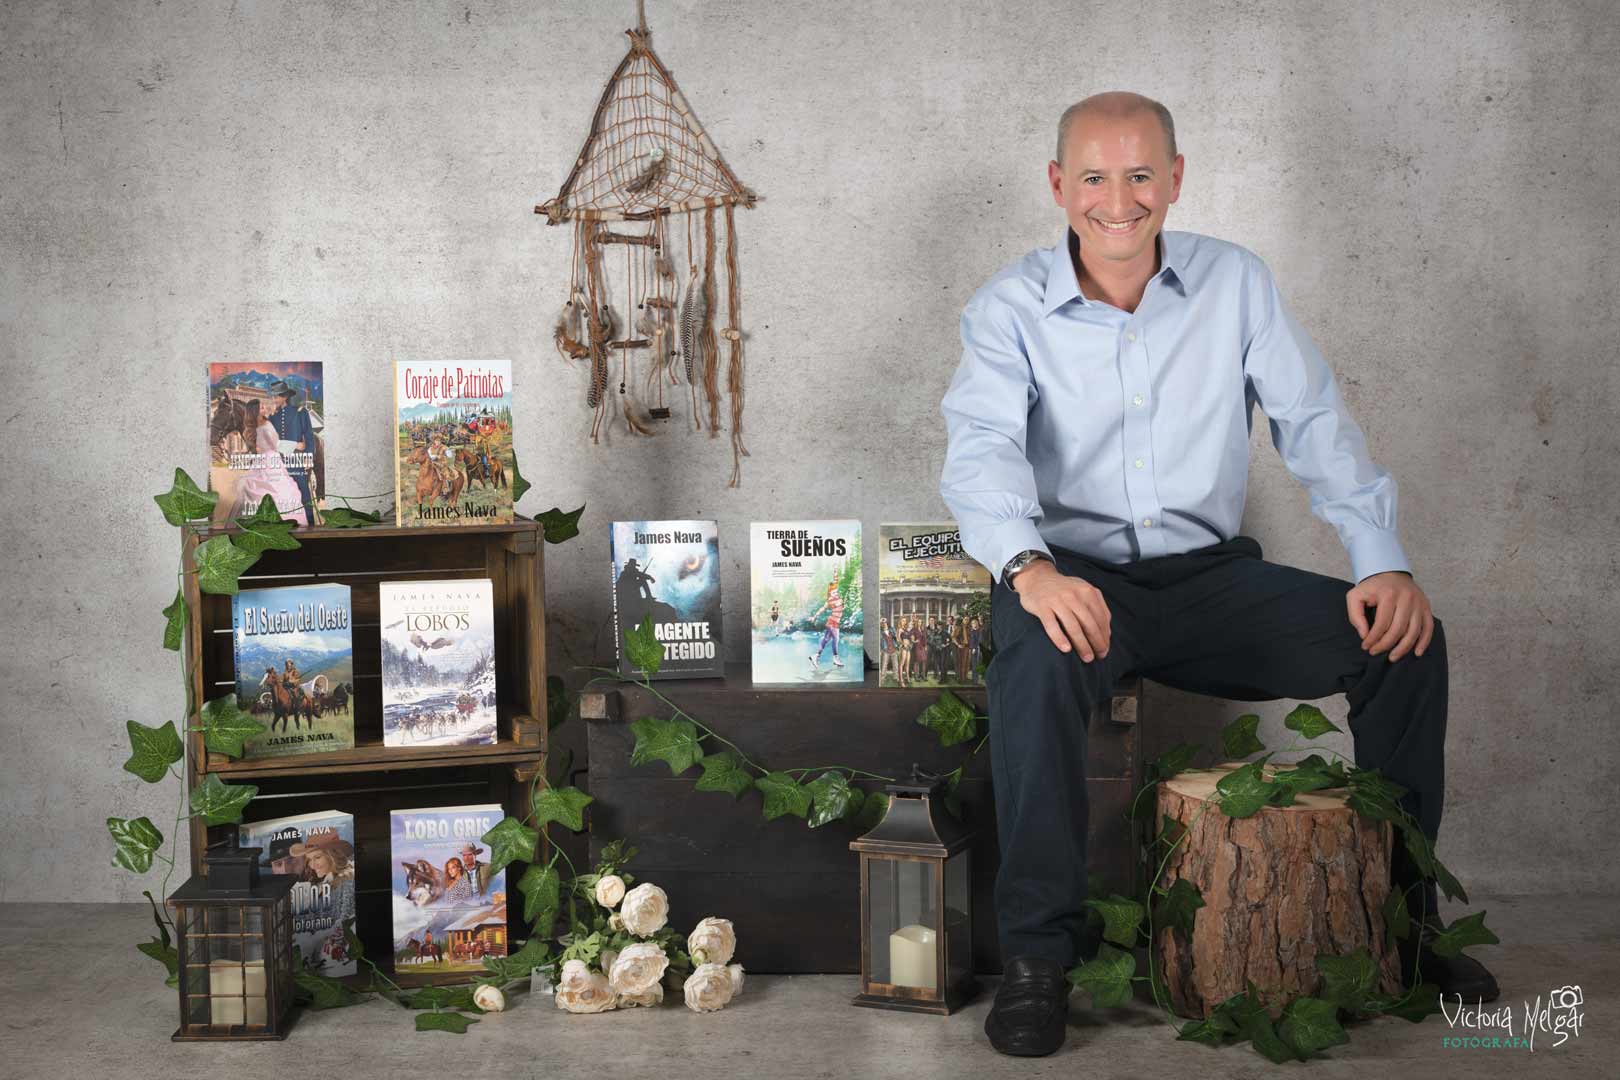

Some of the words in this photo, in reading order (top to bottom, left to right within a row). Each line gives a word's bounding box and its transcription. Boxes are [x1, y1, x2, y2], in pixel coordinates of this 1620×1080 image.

[405, 368, 438, 404] Coraje
[441, 368, 453, 399] de
[457, 368, 504, 399] Patriotas
[284, 452, 314, 468] HONOR
[415, 503, 461, 520] James
[464, 502, 497, 518] Nava
[634, 531, 671, 545] James
[674, 531, 702, 544] Nava
[767, 530, 796, 540] TIERRA
[798, 530, 809, 539] DE
[781, 535, 846, 557] SUEÑOS
[890, 539, 908, 550] EL
[904, 543, 961, 560] EJECUTI
[393, 593, 435, 601] JAMES
[447, 592, 481, 600] NAVA
[243, 607, 258, 635] El
[260, 607, 295, 635] Sueño
[297, 603, 315, 632] del
[318, 602, 348, 631] Oeste
[406, 613, 471, 632] LOBOS
[654, 622, 710, 640] AGENTE
[664, 642, 716, 660] TEGIDO
[267, 735, 305, 746] JAMES
[307, 733, 335, 743] NAVA
[272, 829, 303, 842] JAMES
[305, 827, 332, 837] NAVA
[404, 819, 448, 840] LOBO
[453, 817, 491, 838] GRIS
